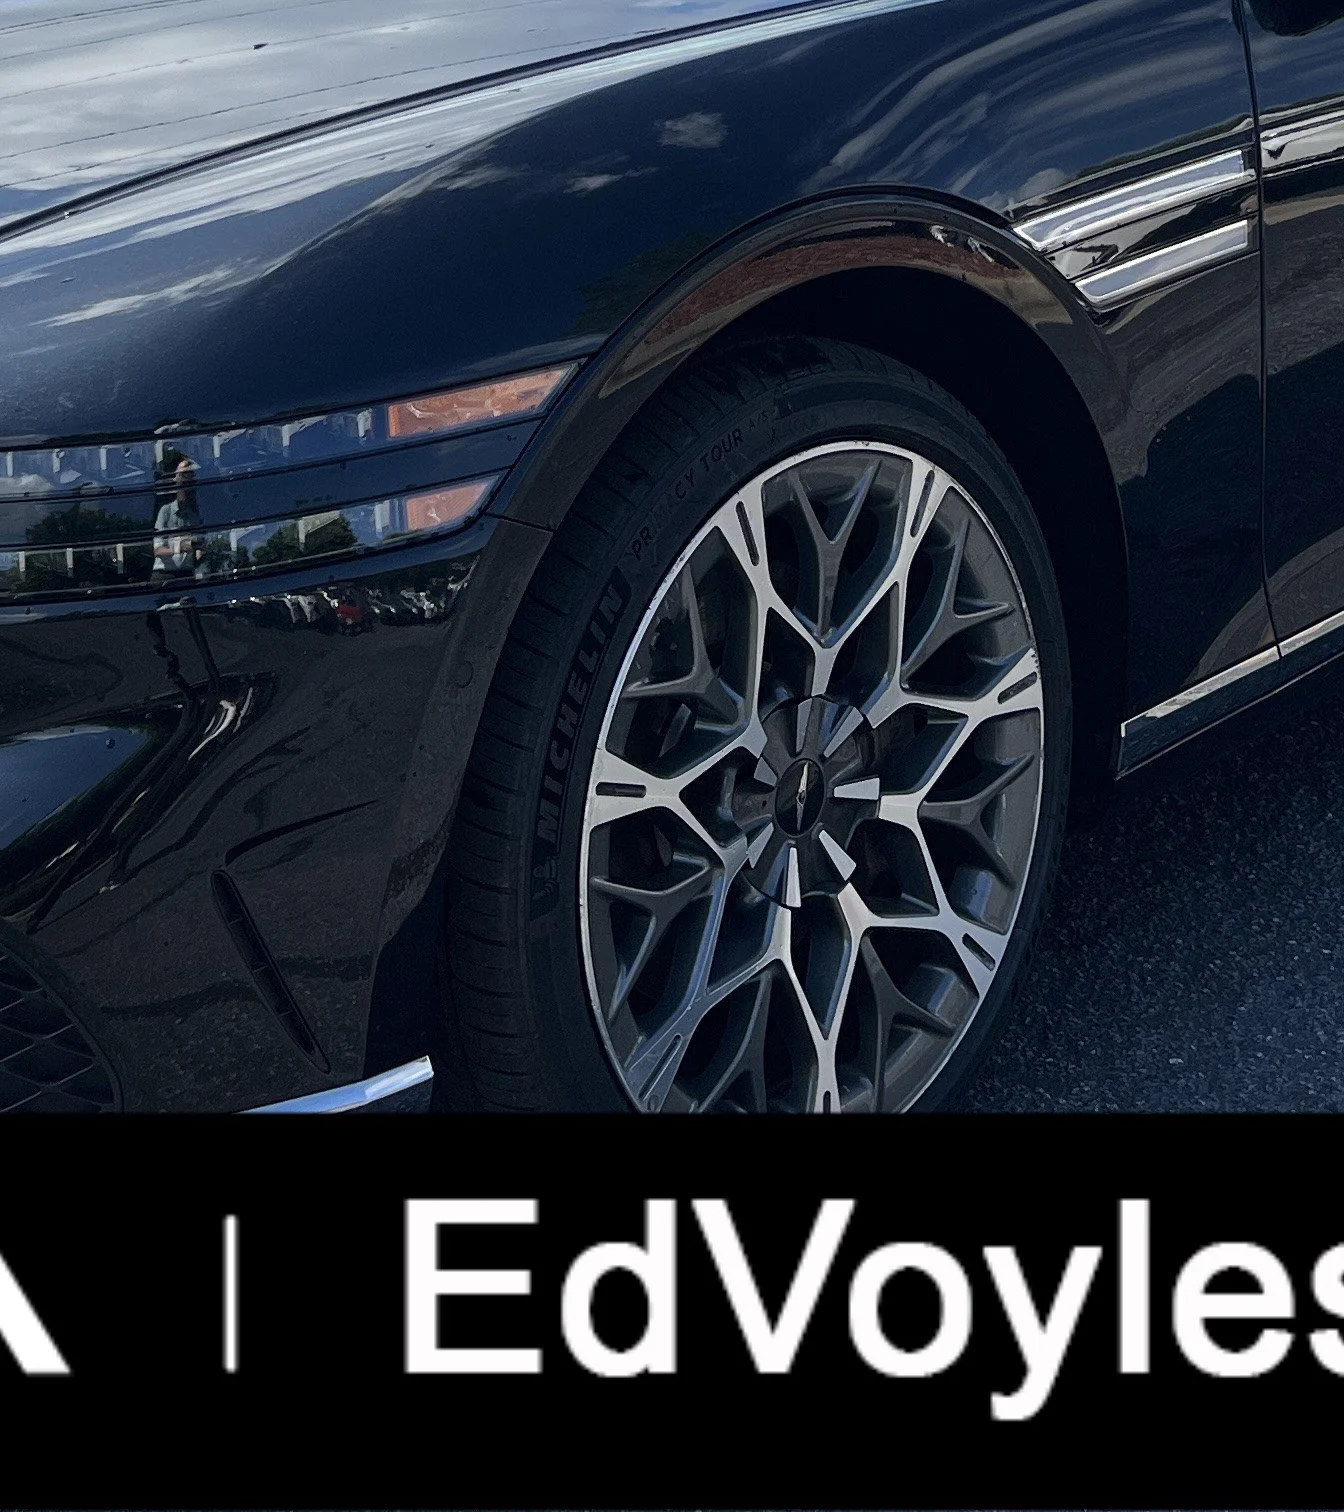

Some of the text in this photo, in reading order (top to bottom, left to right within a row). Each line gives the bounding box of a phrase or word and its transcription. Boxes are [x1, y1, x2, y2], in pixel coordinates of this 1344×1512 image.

[631, 467, 695, 561] PRCY
[699, 428, 745, 473] TOUR
[535, 582, 625, 845] MICHELIN
